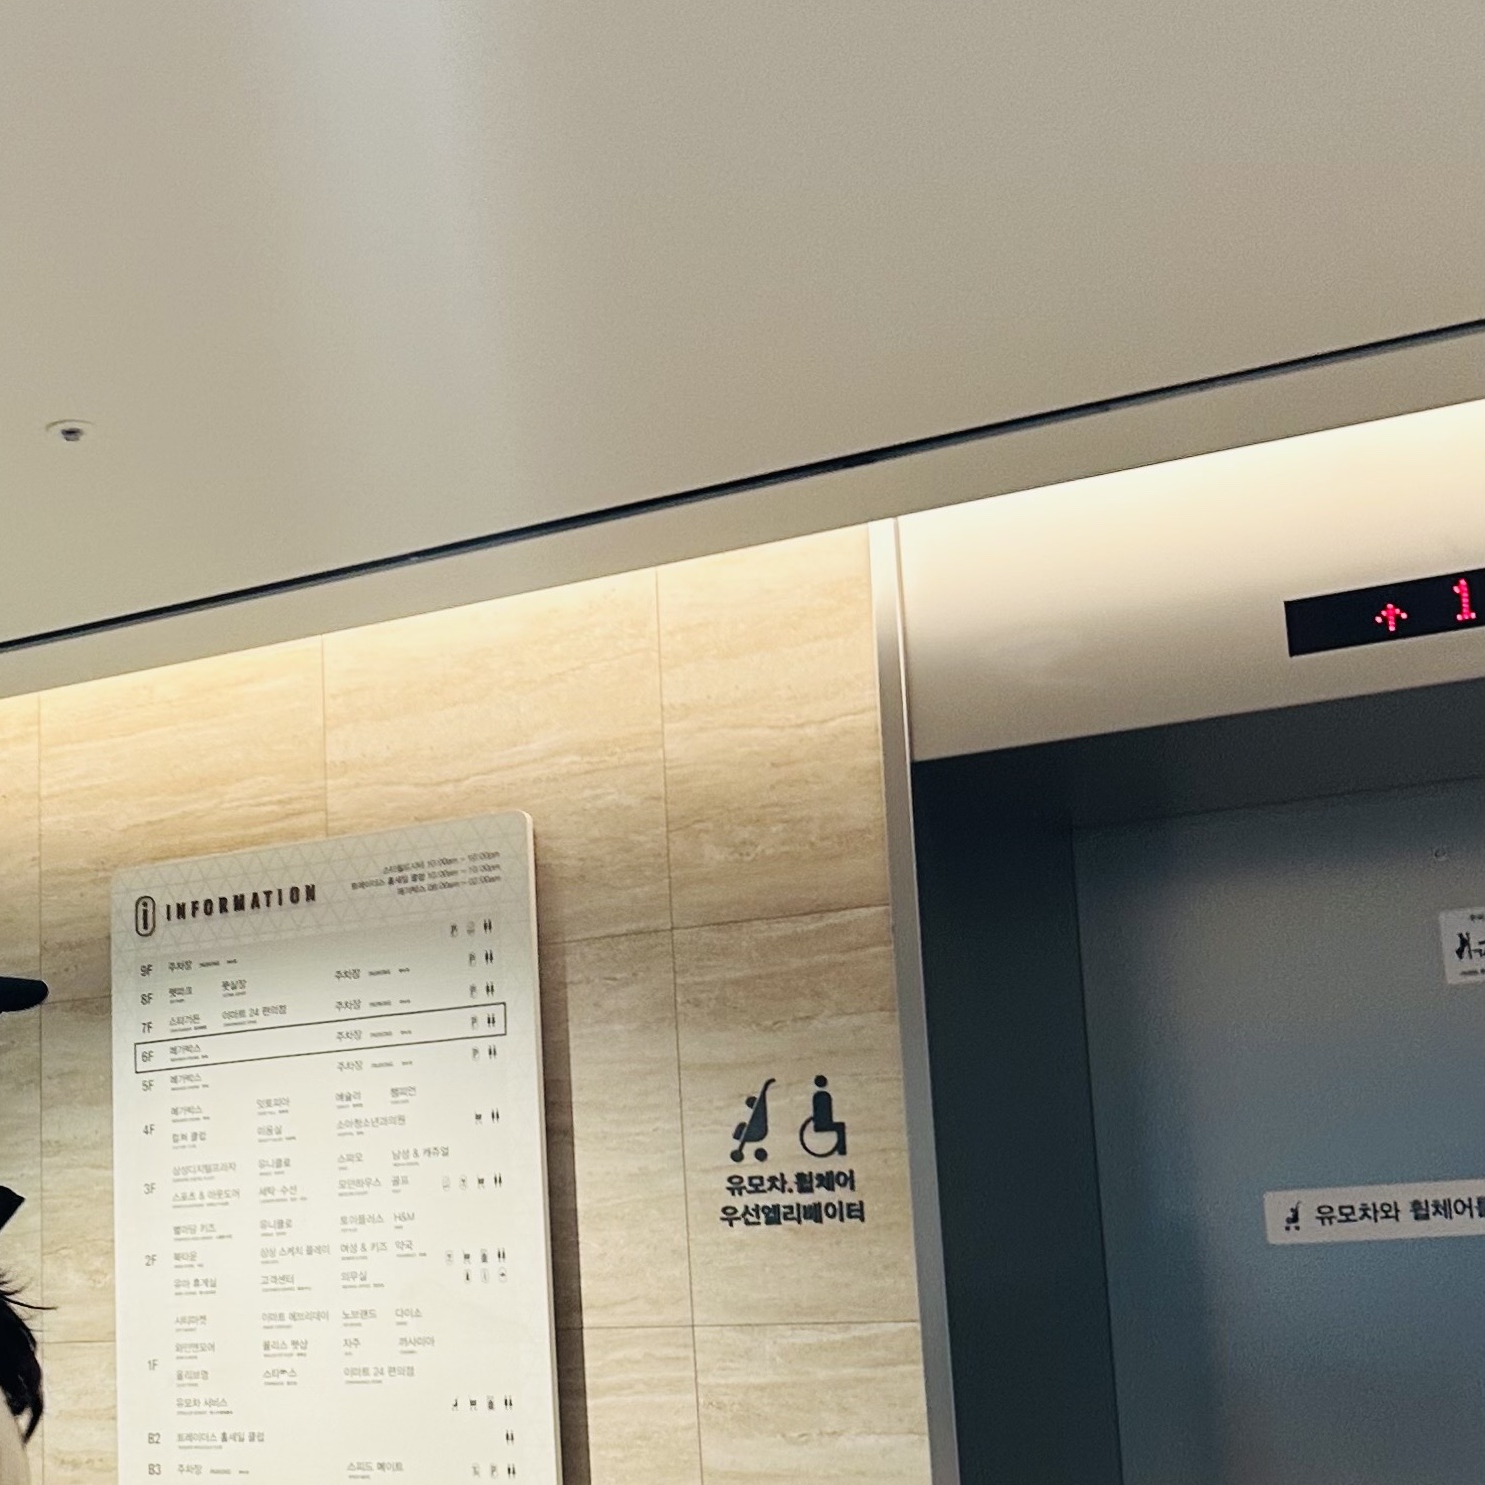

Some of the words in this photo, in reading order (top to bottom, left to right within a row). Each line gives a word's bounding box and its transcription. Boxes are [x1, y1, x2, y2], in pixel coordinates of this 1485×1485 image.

[166, 884, 316, 921] INFORMATION
[140, 964, 153, 977] 9F
[142, 1022, 153, 1033] 7F
[142, 1051, 153, 1062] 6F
[142, 1080, 154, 1091] 5F
[143, 1124, 155, 1135] 4F
[144, 1183, 156, 1194] 3F
[720, 1200, 865, 1227] 우선엘리베이터
[1315, 1201, 1400, 1226] 유모차와
[145, 1255, 157, 1266] 2F
[148, 1359, 158, 1370] 1F
[263, 1369, 297, 1378] 스타스
[373, 1367, 384, 1376] 24
[148, 1433, 161, 1444] B2
[148, 1464, 161, 1475] B3
[177, 1464, 202, 1475] 주차장
